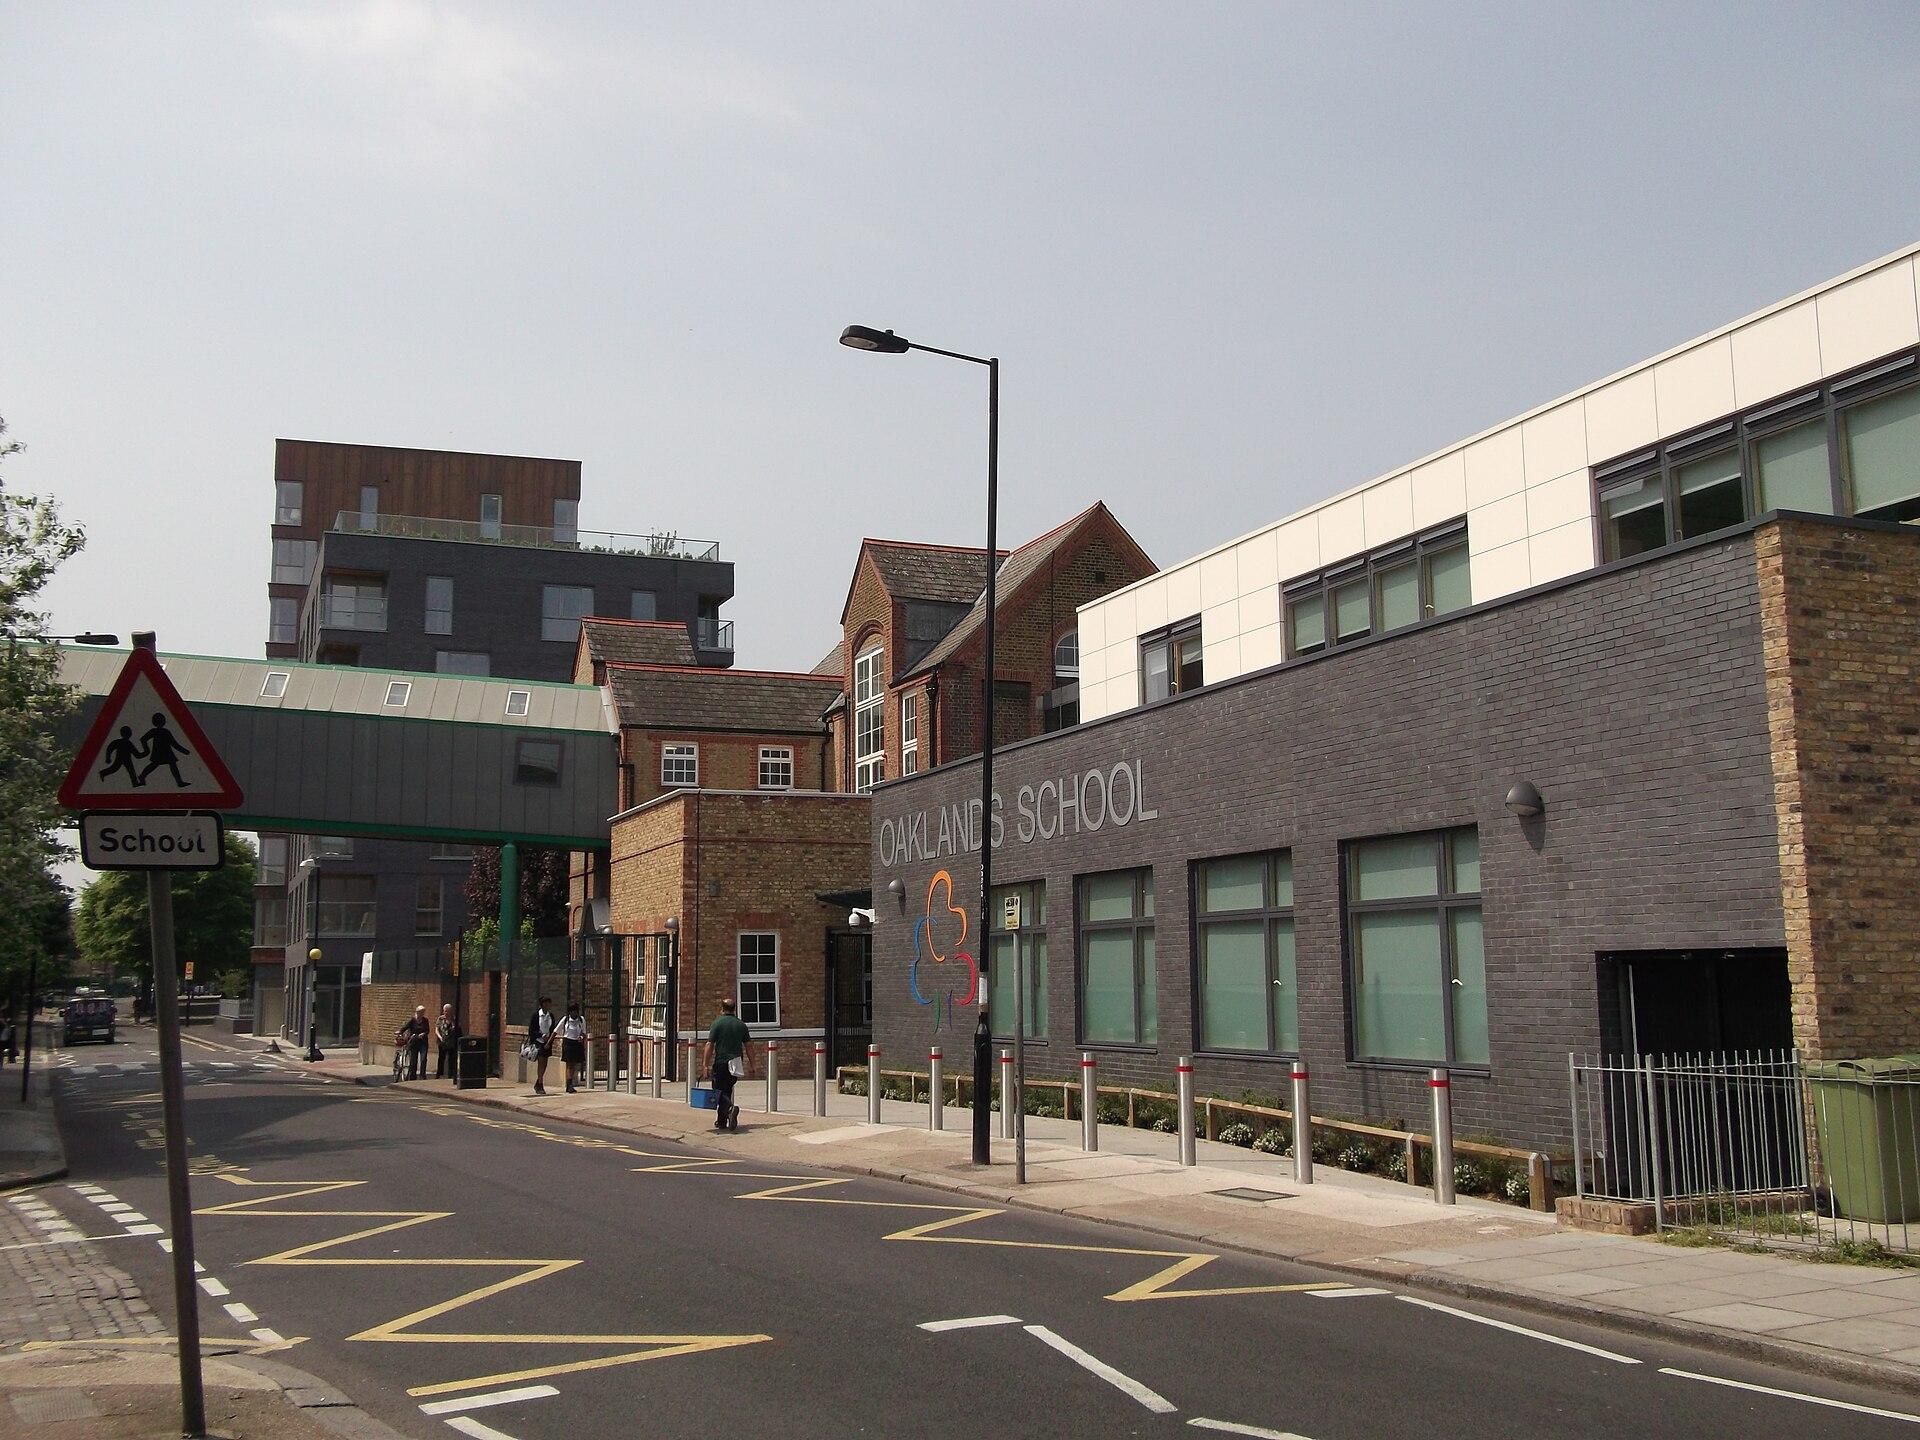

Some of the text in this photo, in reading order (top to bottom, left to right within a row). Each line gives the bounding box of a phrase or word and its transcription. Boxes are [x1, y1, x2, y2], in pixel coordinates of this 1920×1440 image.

[99, 827, 206, 853] School
[879, 759, 1159, 868] OAKLANDS SCHOOL
